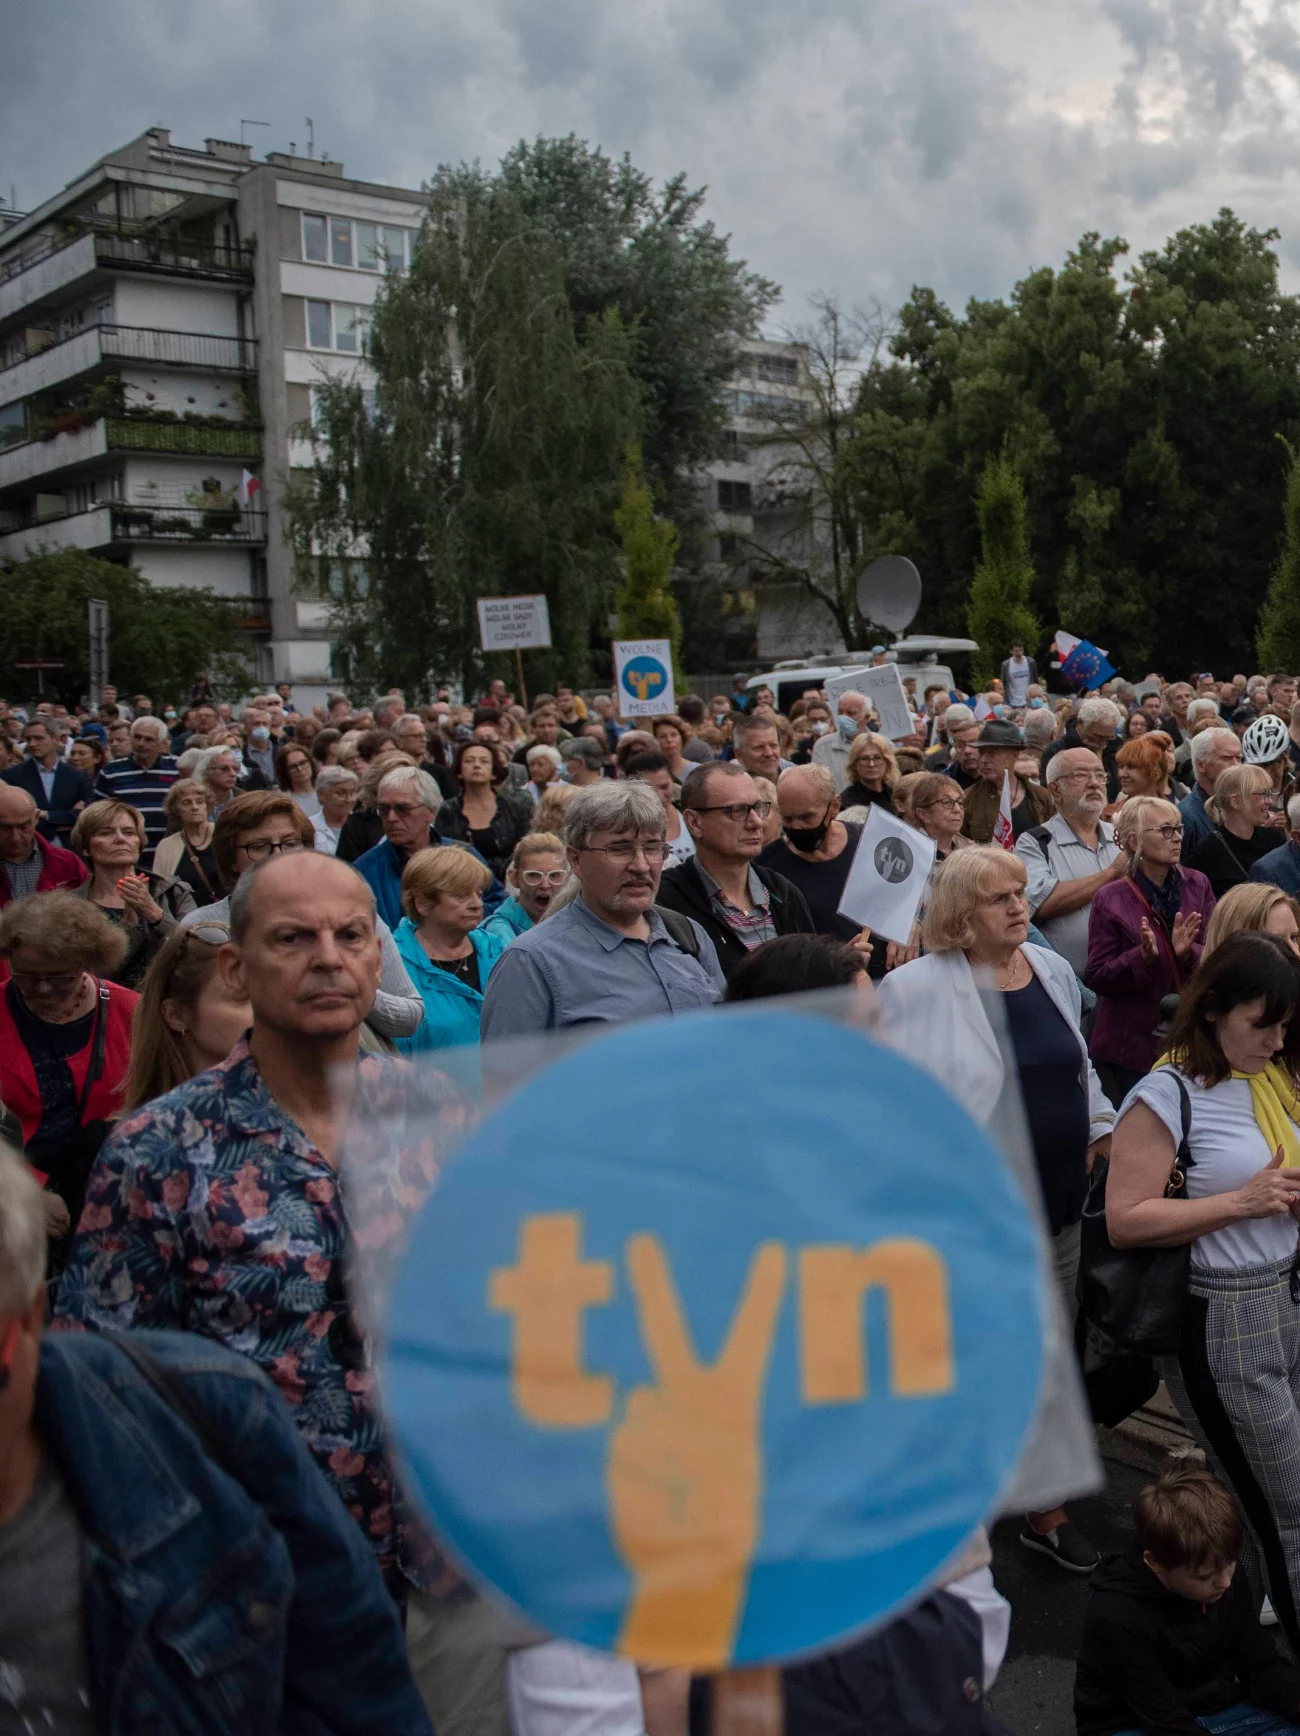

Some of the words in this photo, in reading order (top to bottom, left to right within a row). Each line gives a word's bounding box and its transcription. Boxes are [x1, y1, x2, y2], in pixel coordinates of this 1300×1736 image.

[620, 644, 663, 654] WOLNE
[629, 702, 668, 714] MEDIA
[880, 846, 907, 876] tvn
[489, 1212, 955, 1470] tvn
